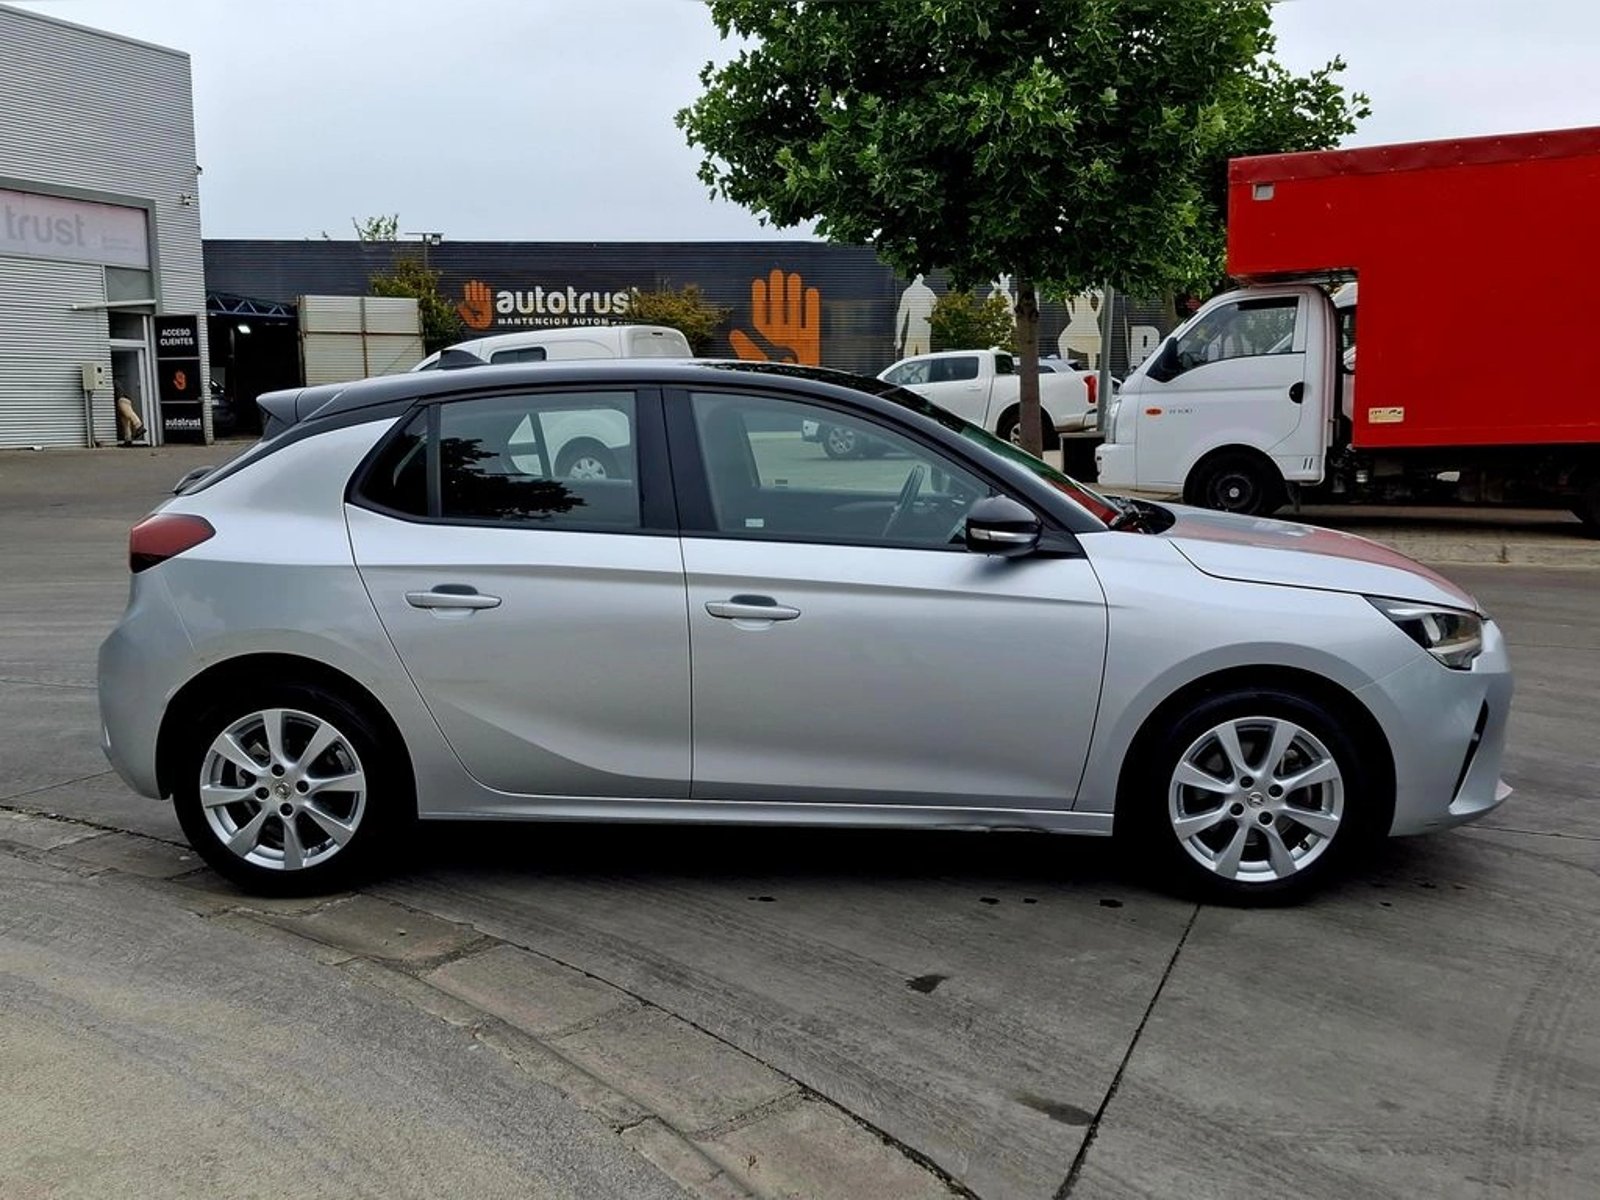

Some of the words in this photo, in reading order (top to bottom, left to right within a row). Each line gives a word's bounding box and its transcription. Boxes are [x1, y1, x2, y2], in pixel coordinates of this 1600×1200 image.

[5, 203, 85, 247] trust
[498, 317, 569, 325] MANTENCION
[162, 328, 191, 337] ACCESO
[160, 337, 193, 346] CLIENTES
